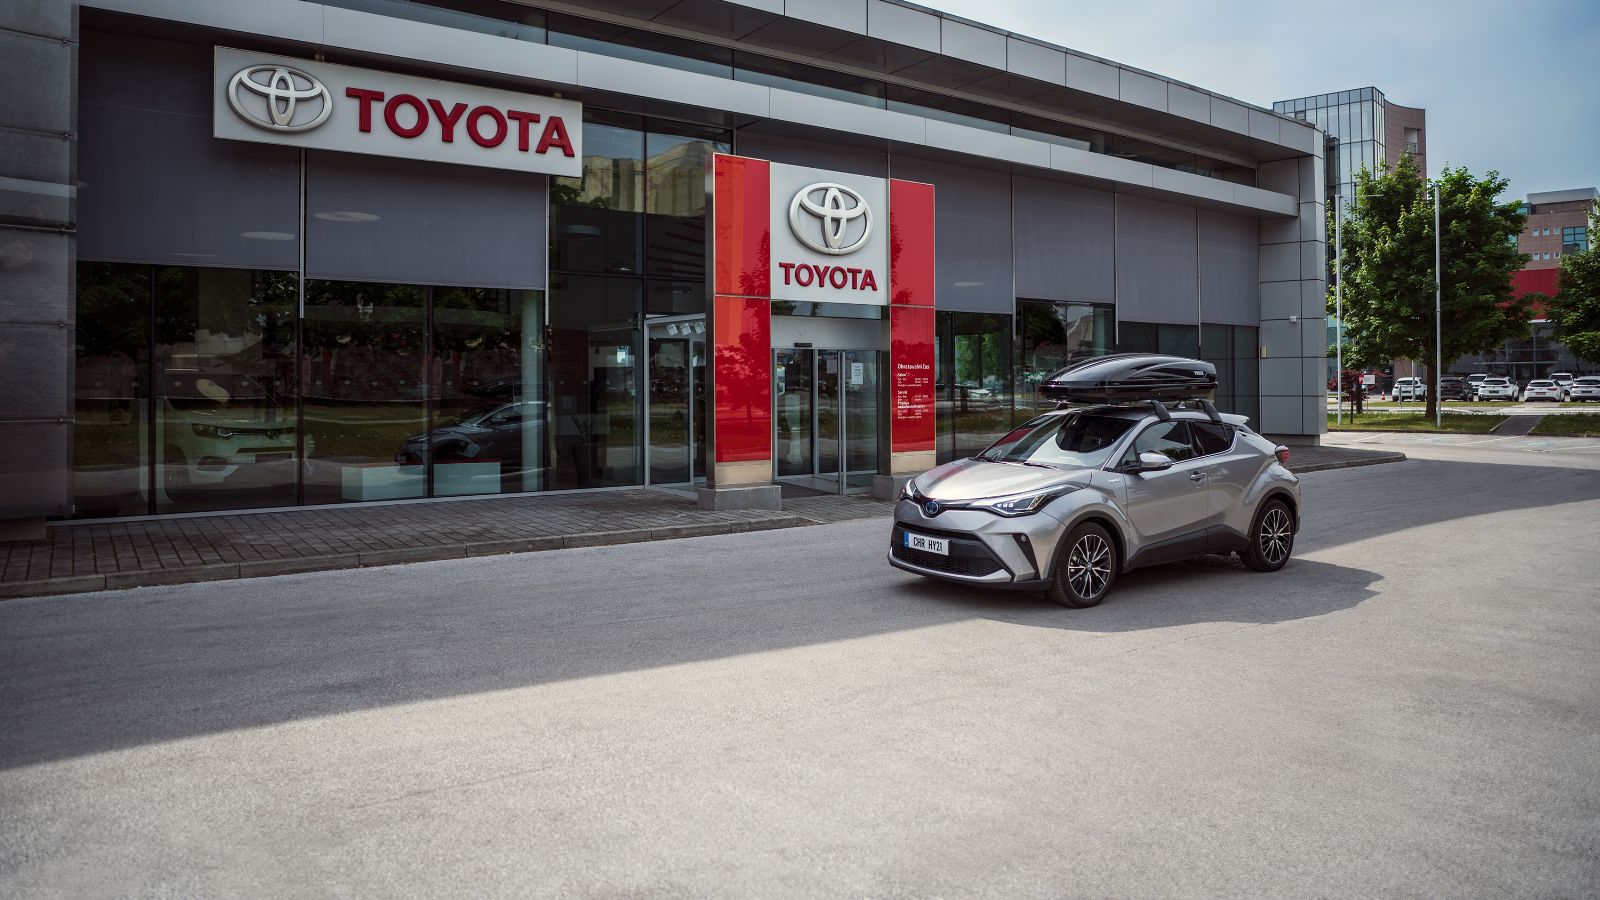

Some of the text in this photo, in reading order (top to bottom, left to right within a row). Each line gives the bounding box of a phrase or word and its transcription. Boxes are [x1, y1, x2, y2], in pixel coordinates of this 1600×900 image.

[346, 87, 575, 157] TOYOTA
[779, 262, 877, 291] TOYOTA
[913, 536, 943, 552] CHR HY21
